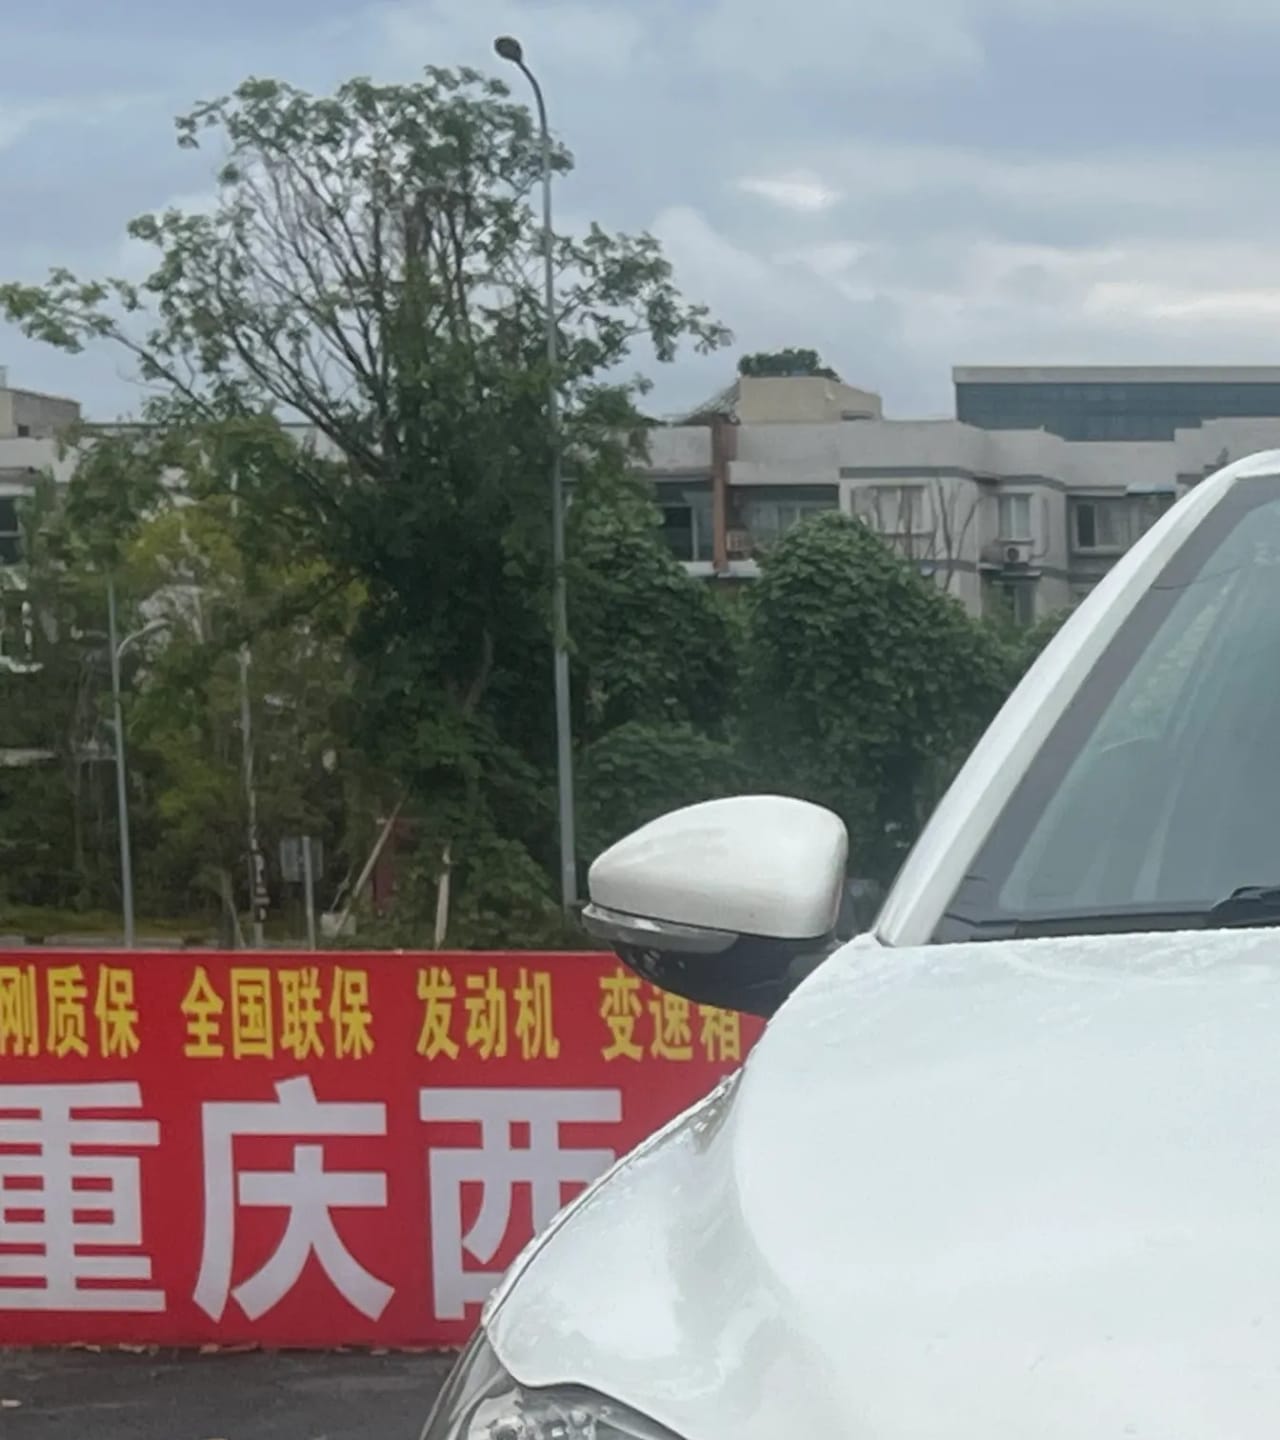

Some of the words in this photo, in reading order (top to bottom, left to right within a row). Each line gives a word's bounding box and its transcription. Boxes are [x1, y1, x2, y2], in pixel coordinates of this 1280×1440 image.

[181, 967, 375, 1059] 全国联保
[415, 967, 561, 1058] 发动机
[0, 1076, 622, 1322] 重庆西
